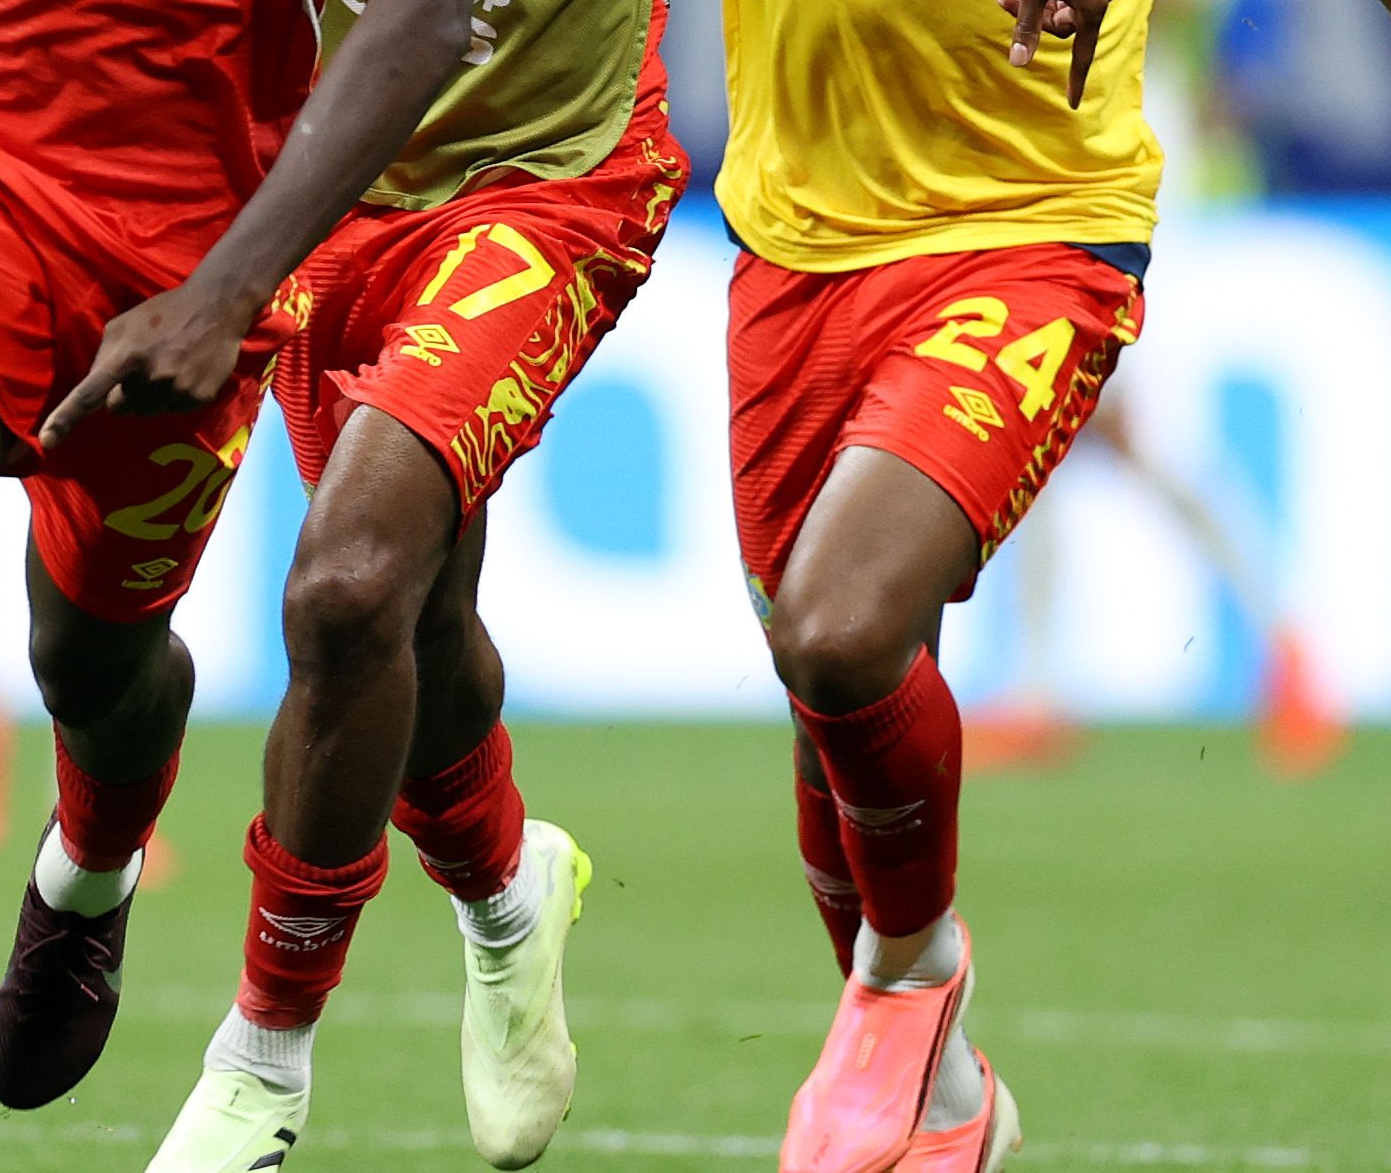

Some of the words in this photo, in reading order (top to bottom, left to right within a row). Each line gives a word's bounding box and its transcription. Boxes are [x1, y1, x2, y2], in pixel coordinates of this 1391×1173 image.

[416, 222, 556, 320] 17
[914, 296, 1076, 423] 24
[942, 403, 991, 443] umbro
[102, 425, 251, 540] 20
[259, 929, 345, 952] umbro
